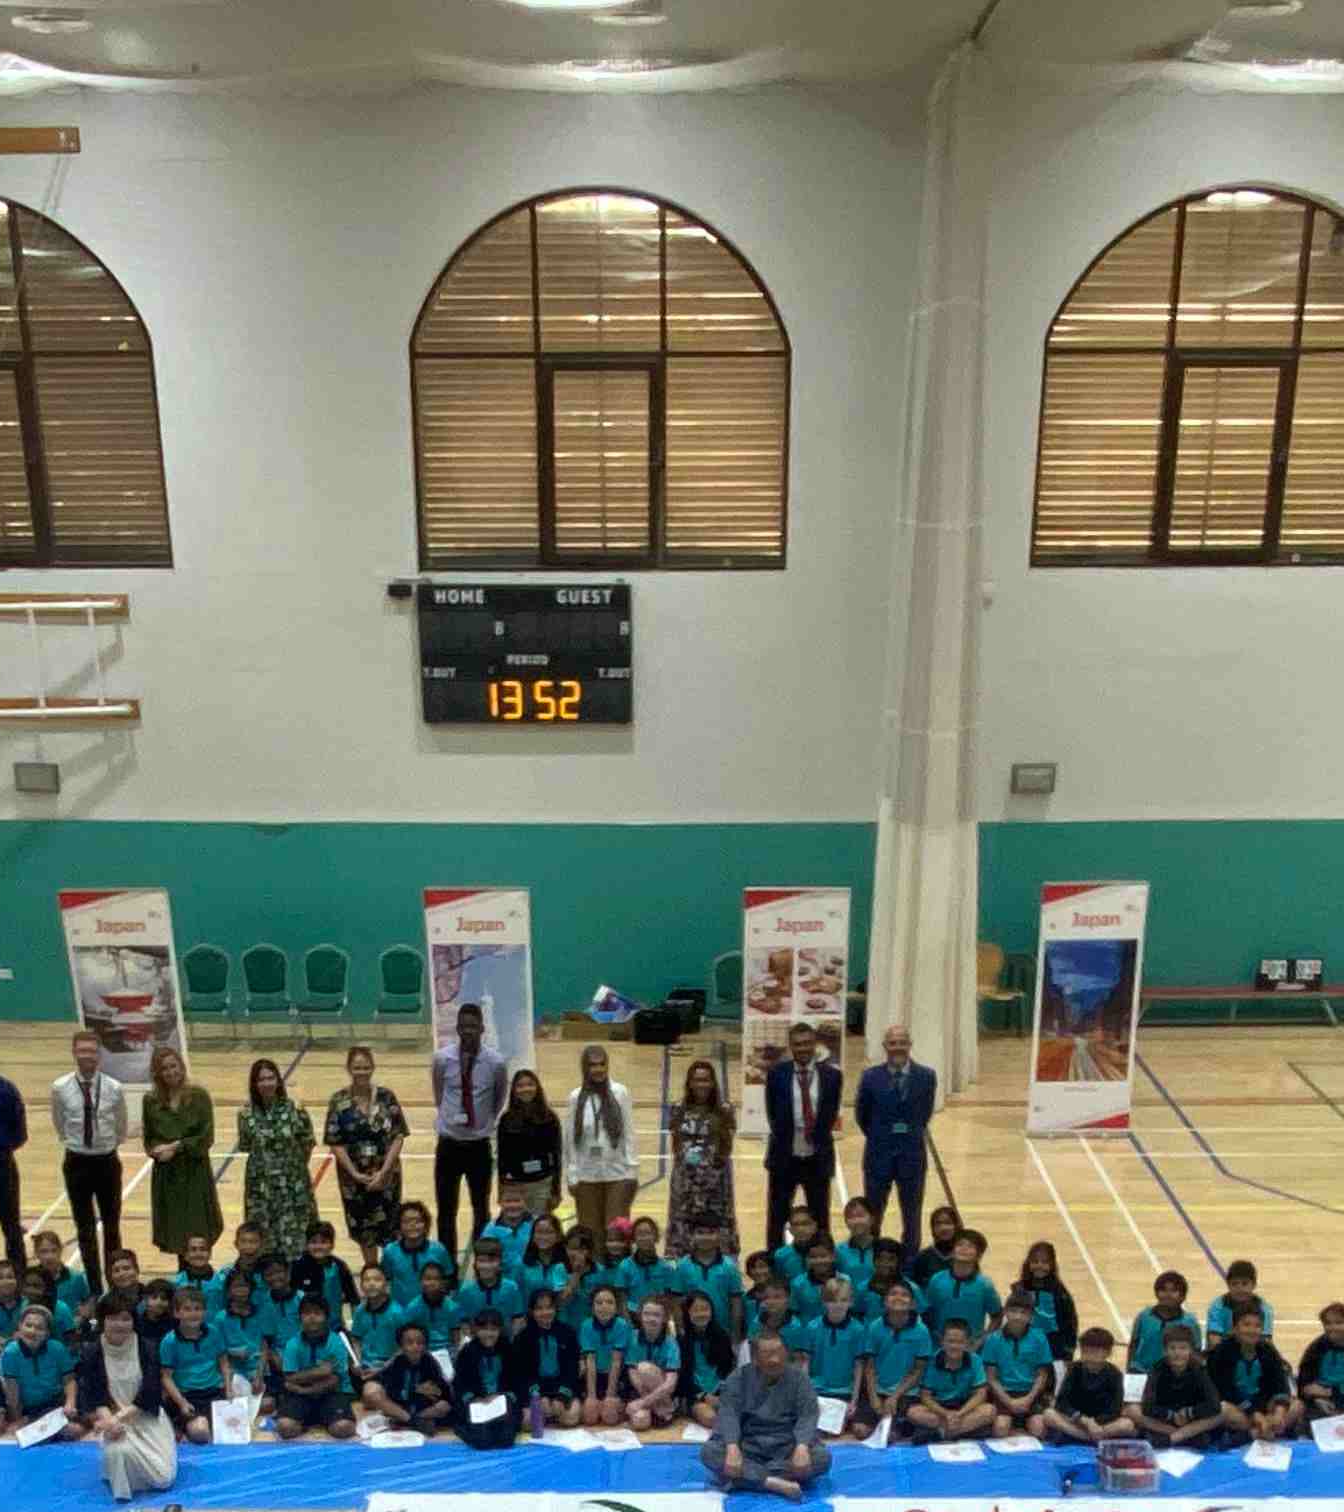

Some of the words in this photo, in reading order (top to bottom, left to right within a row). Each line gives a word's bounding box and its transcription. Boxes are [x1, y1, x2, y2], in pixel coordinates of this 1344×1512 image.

[434, 589, 485, 605] HOME
[556, 589, 612, 605] GUEST
[95, 918, 146, 935] Japan
[457, 917, 504, 934] Japan
[775, 917, 825, 936] Japan
[1072, 912, 1120, 930] Japan
